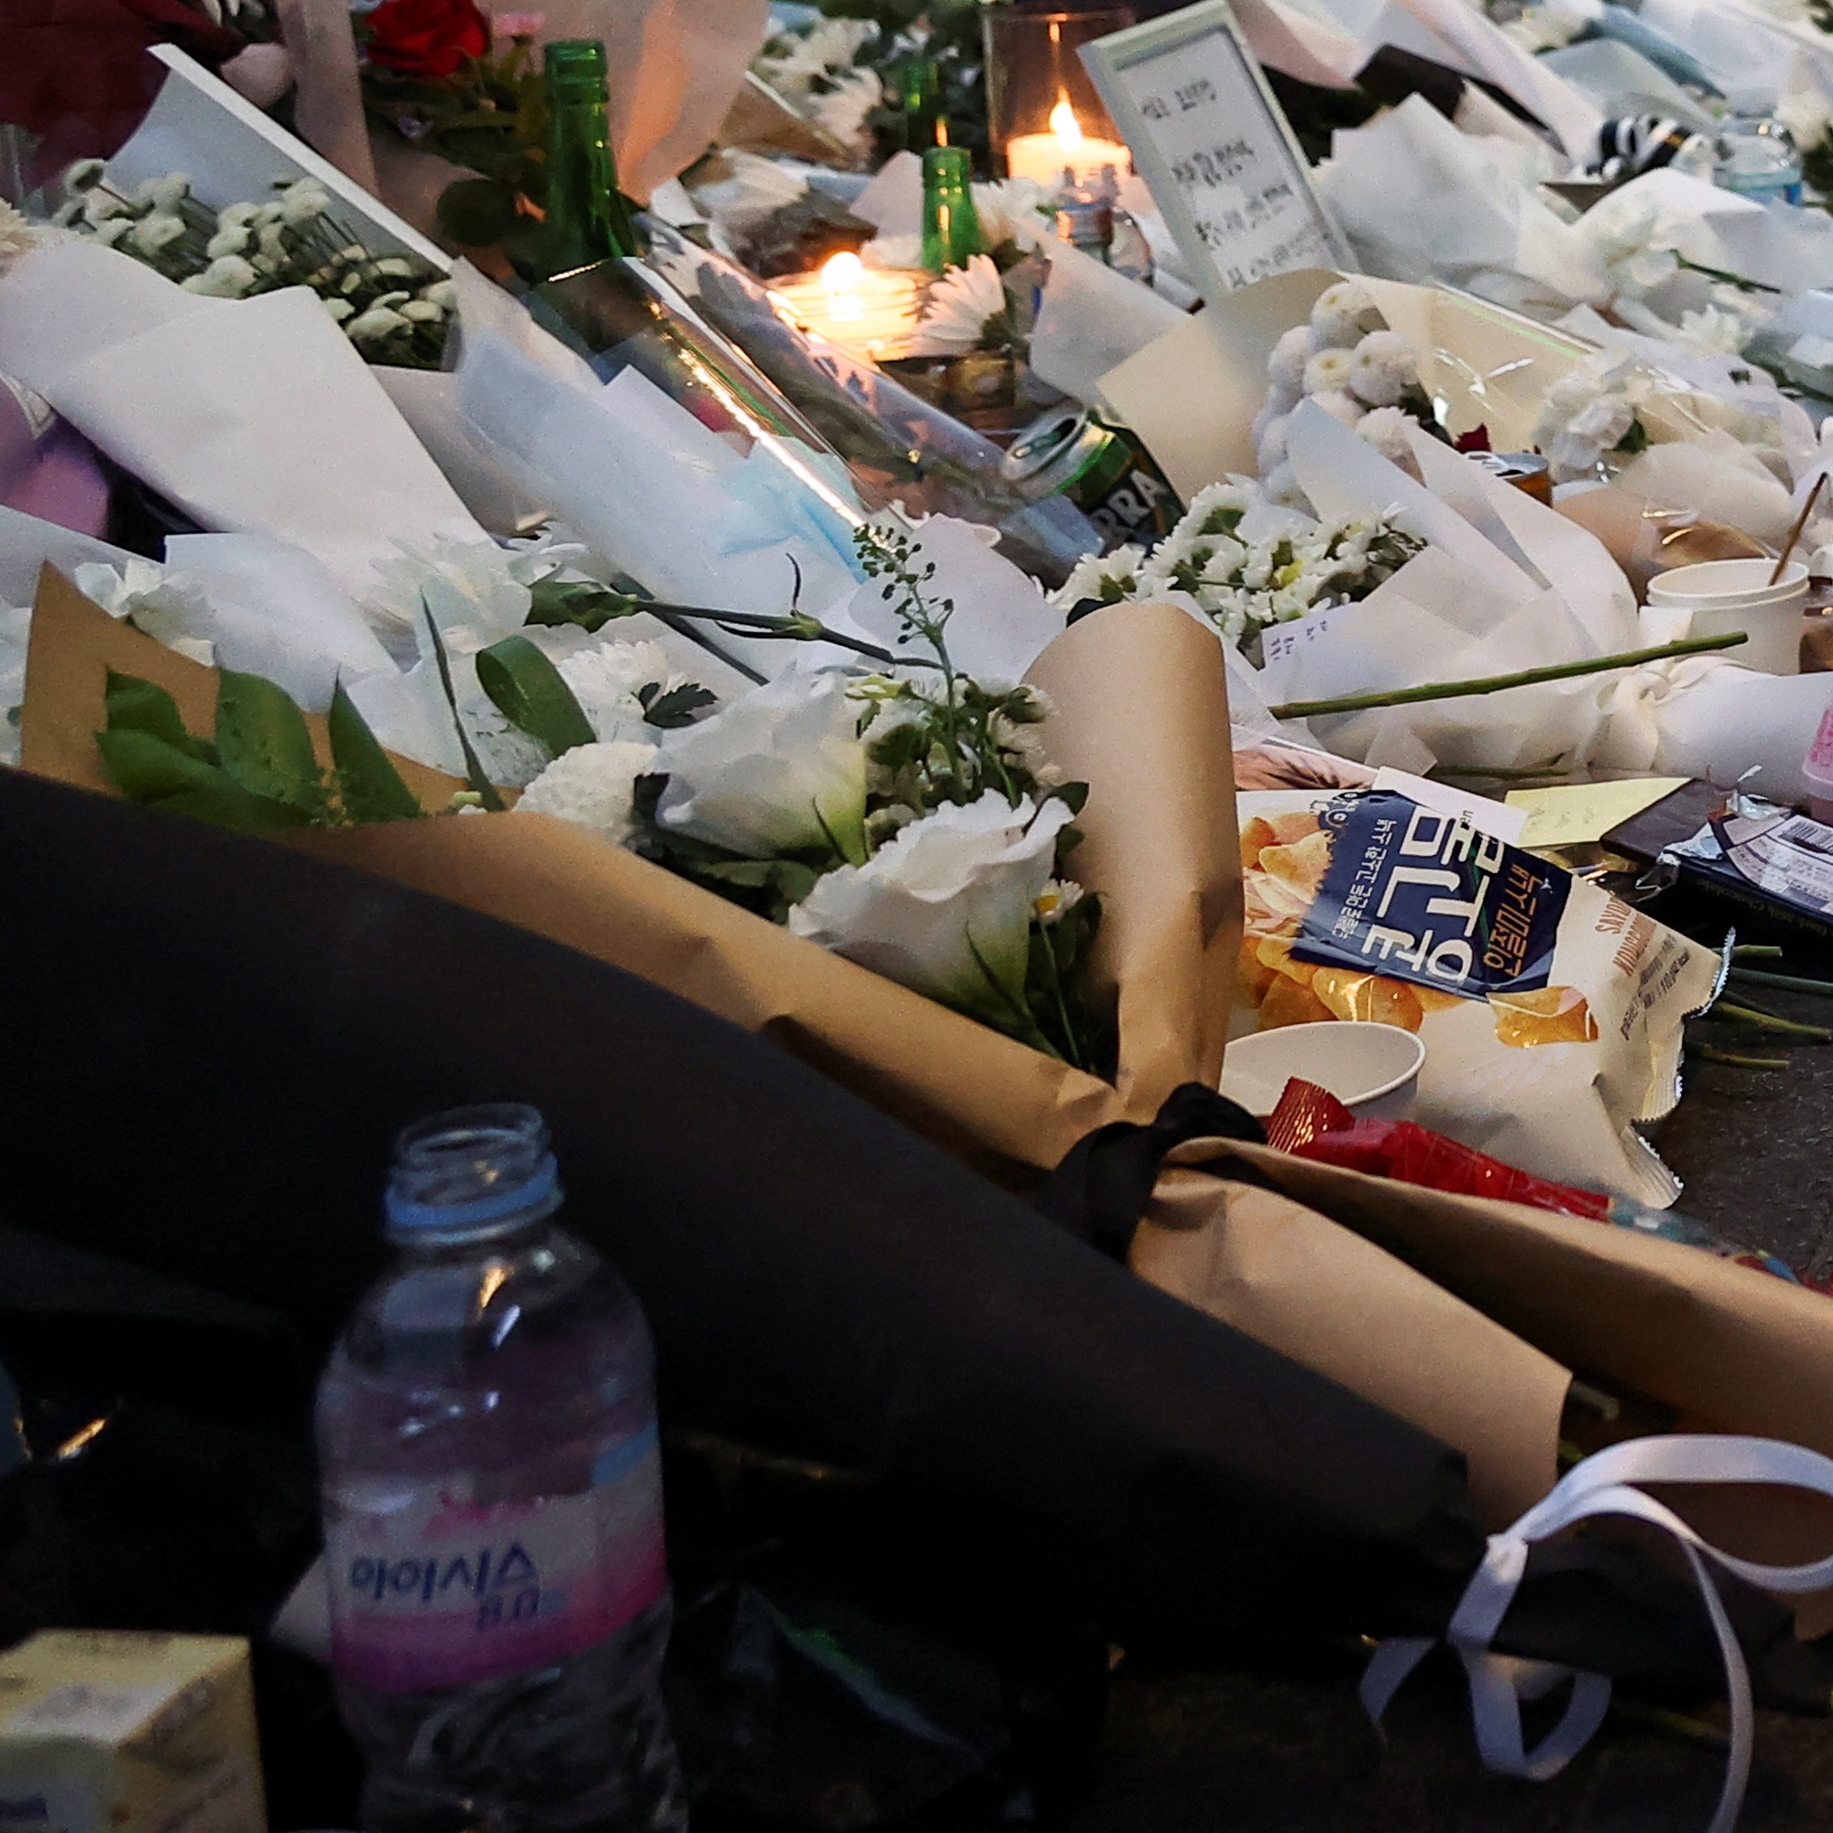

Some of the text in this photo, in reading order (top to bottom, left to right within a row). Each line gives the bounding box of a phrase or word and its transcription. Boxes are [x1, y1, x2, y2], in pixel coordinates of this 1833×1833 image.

[1355, 846, 1388, 884] 고소한
[1373, 817, 1398, 846] 스낵
[1360, 804, 1506, 982] 콩고물
